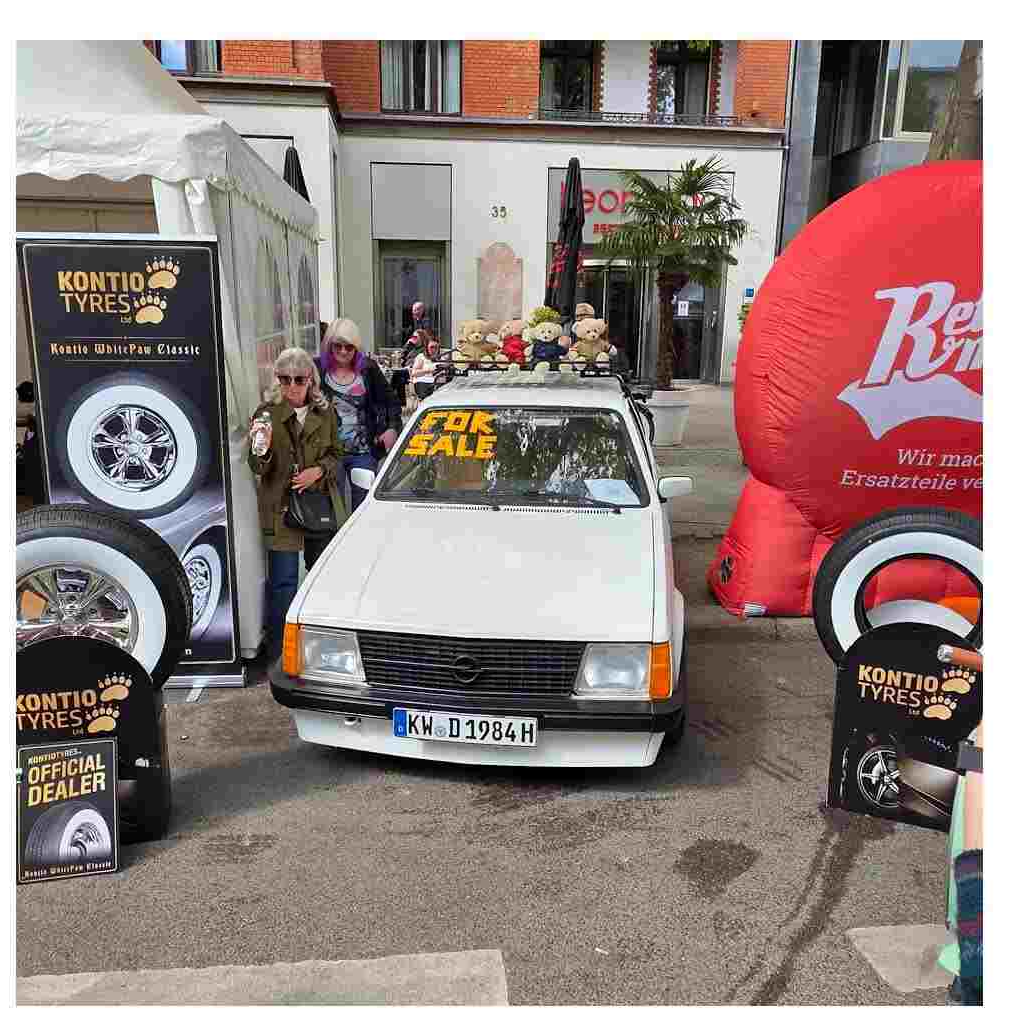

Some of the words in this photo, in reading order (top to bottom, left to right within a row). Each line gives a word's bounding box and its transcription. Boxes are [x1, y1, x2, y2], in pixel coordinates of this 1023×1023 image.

[491, 206, 507, 218] 35
[57, 271, 145, 292] KONTIO
[59, 292, 131, 314] TYRES
[50, 342, 88, 355] Kontio
[157, 342, 201, 355] Classic
[420, 410, 498, 433] FOR
[404, 432, 498, 460] SALE
[896, 448, 937, 466] Wir
[840, 469, 957, 490] Ersatzteile
[858, 664, 939, 692] KONTIO
[858, 681, 921, 707] TYRES
[16, 708, 83, 731] TYRES
[408, 713, 433, 736] KW
[28, 752, 106, 785] OFFICIAL
[27, 771, 106, 807] DEALER
